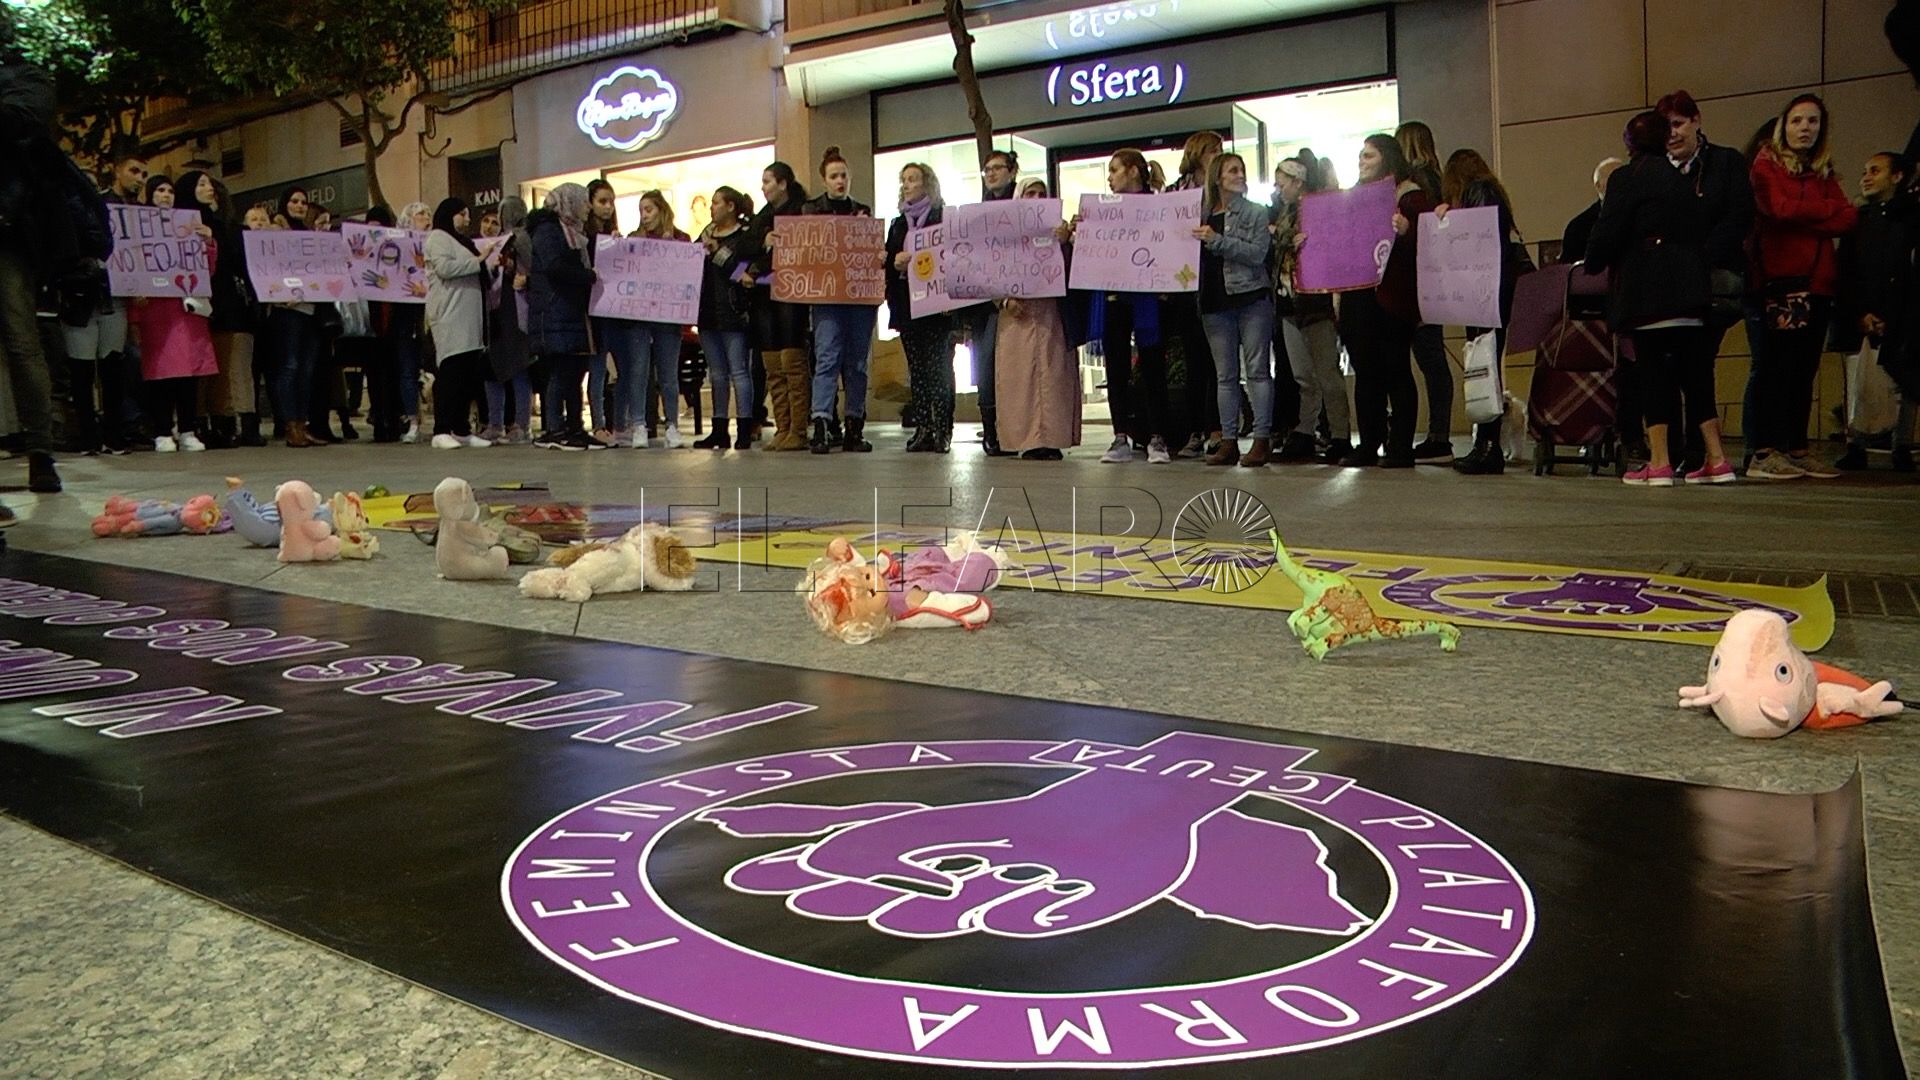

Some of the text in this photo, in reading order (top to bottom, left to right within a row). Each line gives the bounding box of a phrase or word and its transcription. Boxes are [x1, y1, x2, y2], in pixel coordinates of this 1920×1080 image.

[774, 268, 836, 299] SOLA
[525, 743, 955, 963] FEMINISTA
[903, 814, 1514, 1055] PLATAFORMA
